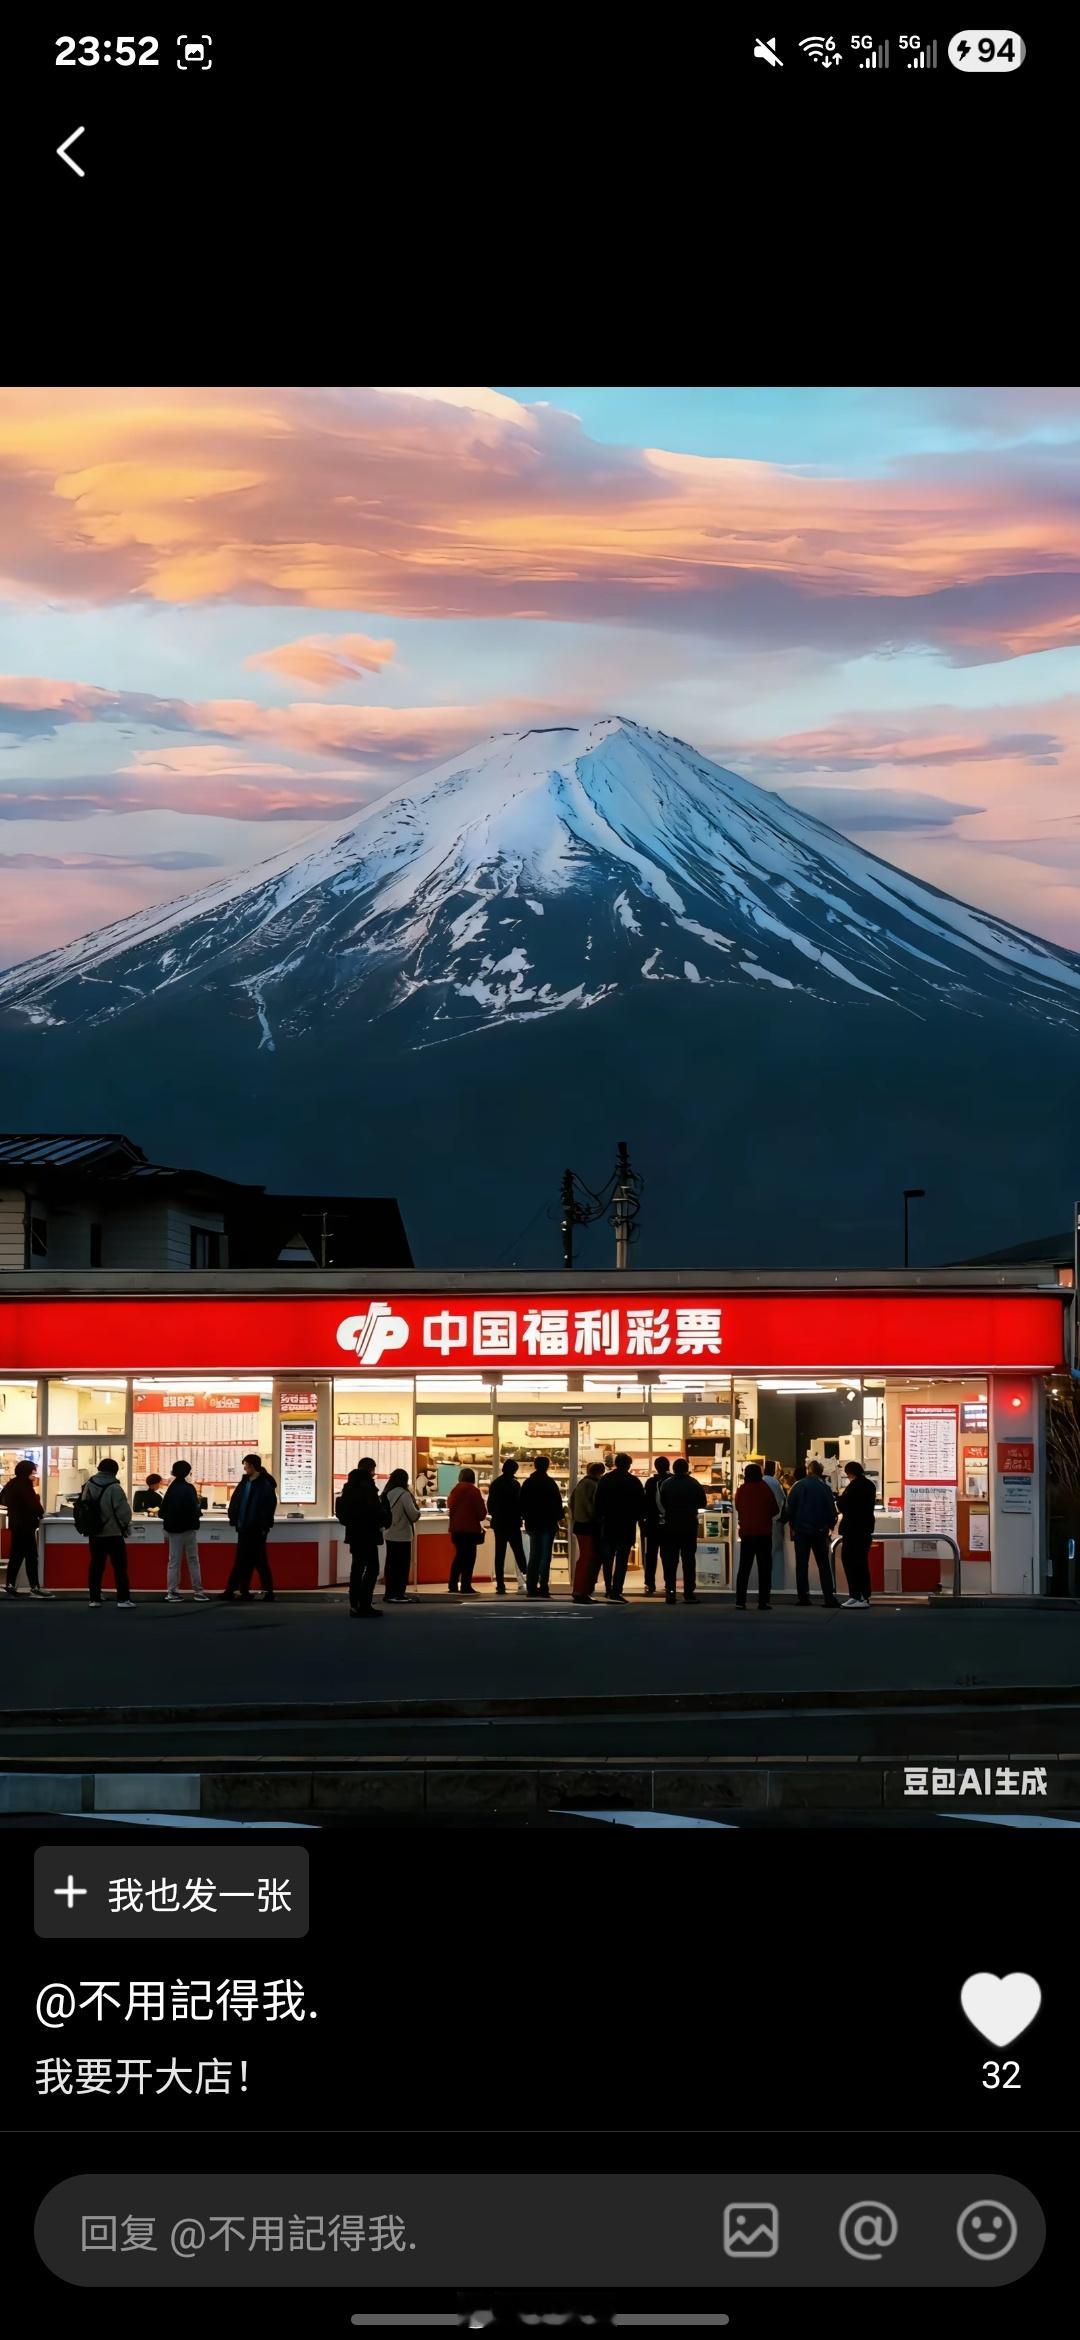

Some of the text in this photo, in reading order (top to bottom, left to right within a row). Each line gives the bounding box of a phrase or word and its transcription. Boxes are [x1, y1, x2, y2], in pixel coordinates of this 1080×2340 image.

[55, 35, 160, 67] 23:52
[850, 34, 873, 50] 5G
[898, 34, 921, 50] 5G
[977, 37, 1016, 63] 94
[422, 1308, 723, 1357] 中国福利彩票
[108, 1876, 293, 1913] 我也发一张
[35, 1978, 318, 2029] @不用記得我.
[982, 2060, 1023, 2090] 32
[81, 2213, 418, 2259] 回复 @不用記得我.
